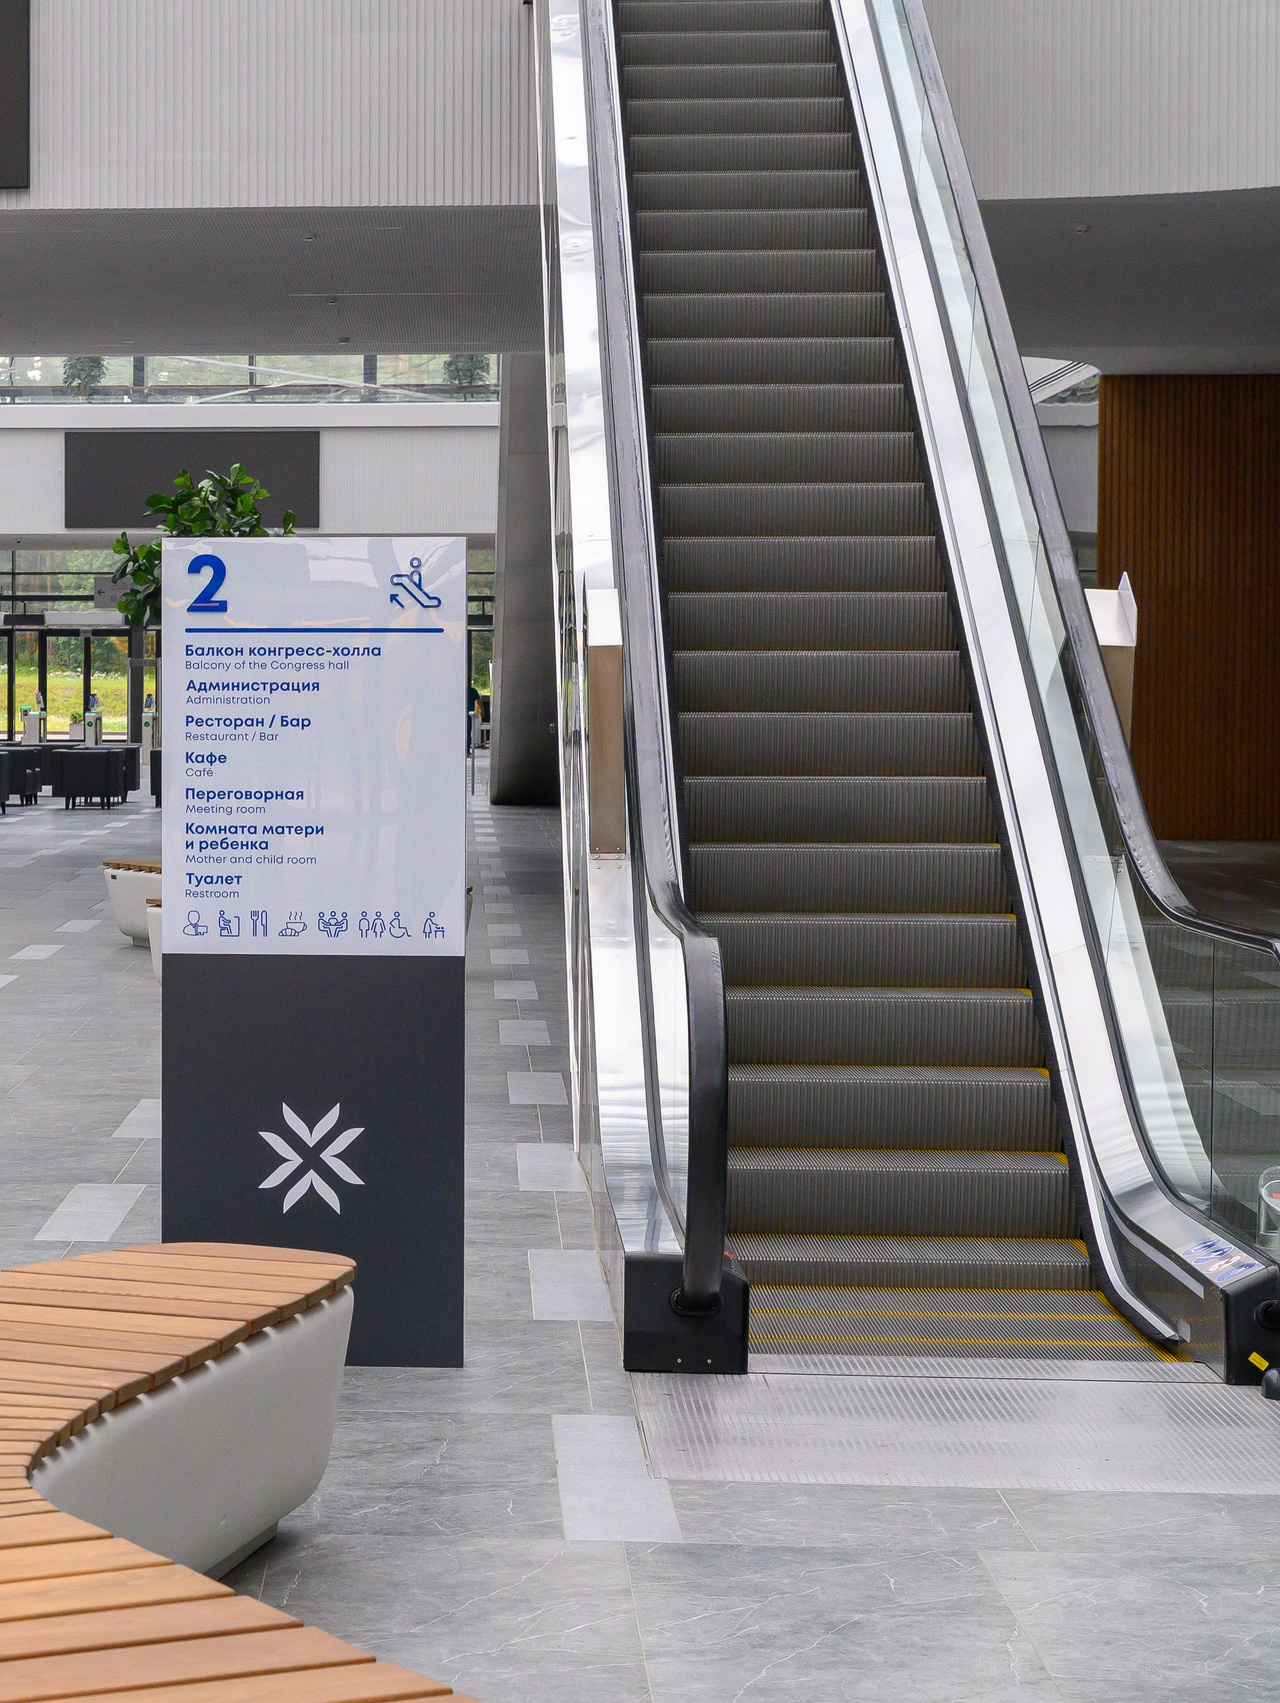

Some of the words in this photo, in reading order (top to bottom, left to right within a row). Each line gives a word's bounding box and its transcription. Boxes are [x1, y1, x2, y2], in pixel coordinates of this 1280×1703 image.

[185, 554, 228, 614] 2
[185, 644, 243, 656] Балкон
[248, 646, 381, 659] конгресс-холла
[185, 660, 231, 671] Balcony
[233, 660, 246, 669] of
[248, 661, 267, 669] the
[270, 661, 325, 672] Congress
[328, 660, 349, 670] hall
[185, 680, 319, 694] Администрация
[185, 695, 270, 704] Administration
[185, 715, 264, 730] Ресторан
[268, 714, 276, 728] /
[280, 715, 311, 730] Бар
[185, 732, 248, 741] Restaurant
[251, 732, 256, 741] /
[259, 732, 279, 741] Bar
[185, 752, 227, 766] Кафе
[185, 768, 213, 777] Café
[185, 788, 304, 803] Переговорная
[185, 804, 232, 815] Meeting
[185, 823, 257, 835] Комната
[261, 826, 324, 838] матери
[185, 840, 194, 849] и
[198, 837, 268, 853] ребенка
[185, 854, 227, 864] Mother
[229, 855, 252, 864] and
[255, 855, 283, 864] child
[286, 856, 316, 864] room
[185, 873, 242, 887] Туалет
[185, 889, 239, 898] Restroom
